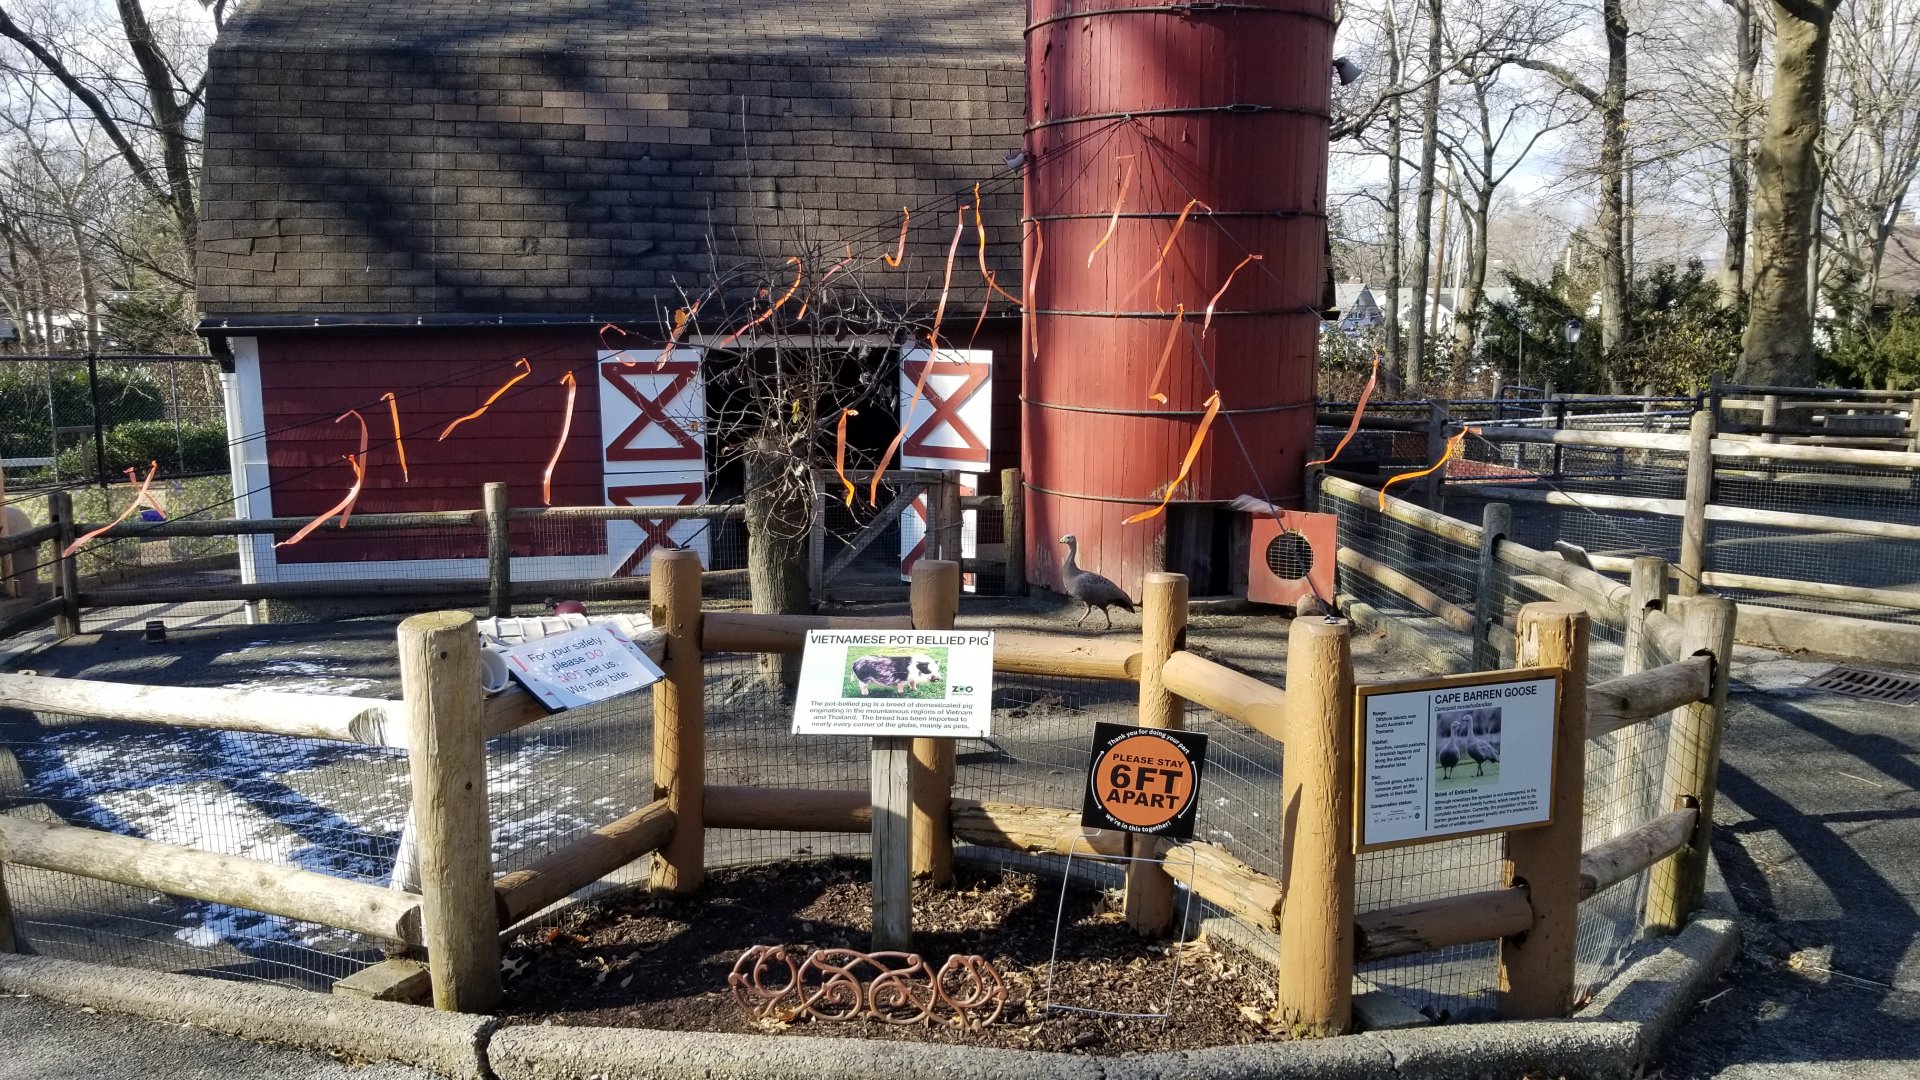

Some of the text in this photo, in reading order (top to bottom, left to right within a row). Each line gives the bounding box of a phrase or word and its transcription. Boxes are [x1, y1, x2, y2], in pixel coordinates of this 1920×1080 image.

[527, 636, 607, 662] For your safety,
[811, 635, 989, 646] VIETNAMESE POT BELLIED PIG
[552, 650, 604, 672] please DO
[558, 670, 584, 683] NOT
[585, 666, 602, 676] pet
[566, 685, 586, 695] We
[588, 677, 610, 690] may
[1435, 685, 1537, 704] CAPE BARREN GOOSE
[1108, 734, 1126, 746] Thank
[1126, 730, 1138, 738] you
[1149, 730, 1166, 739] doing
[1167, 734, 1181, 746] your
[1178, 743, 1190, 755] part
[1113, 754, 1185, 768] PLEASE STAY
[1106, 789, 1179, 810] APART
[1129, 824, 1141, 832] this
